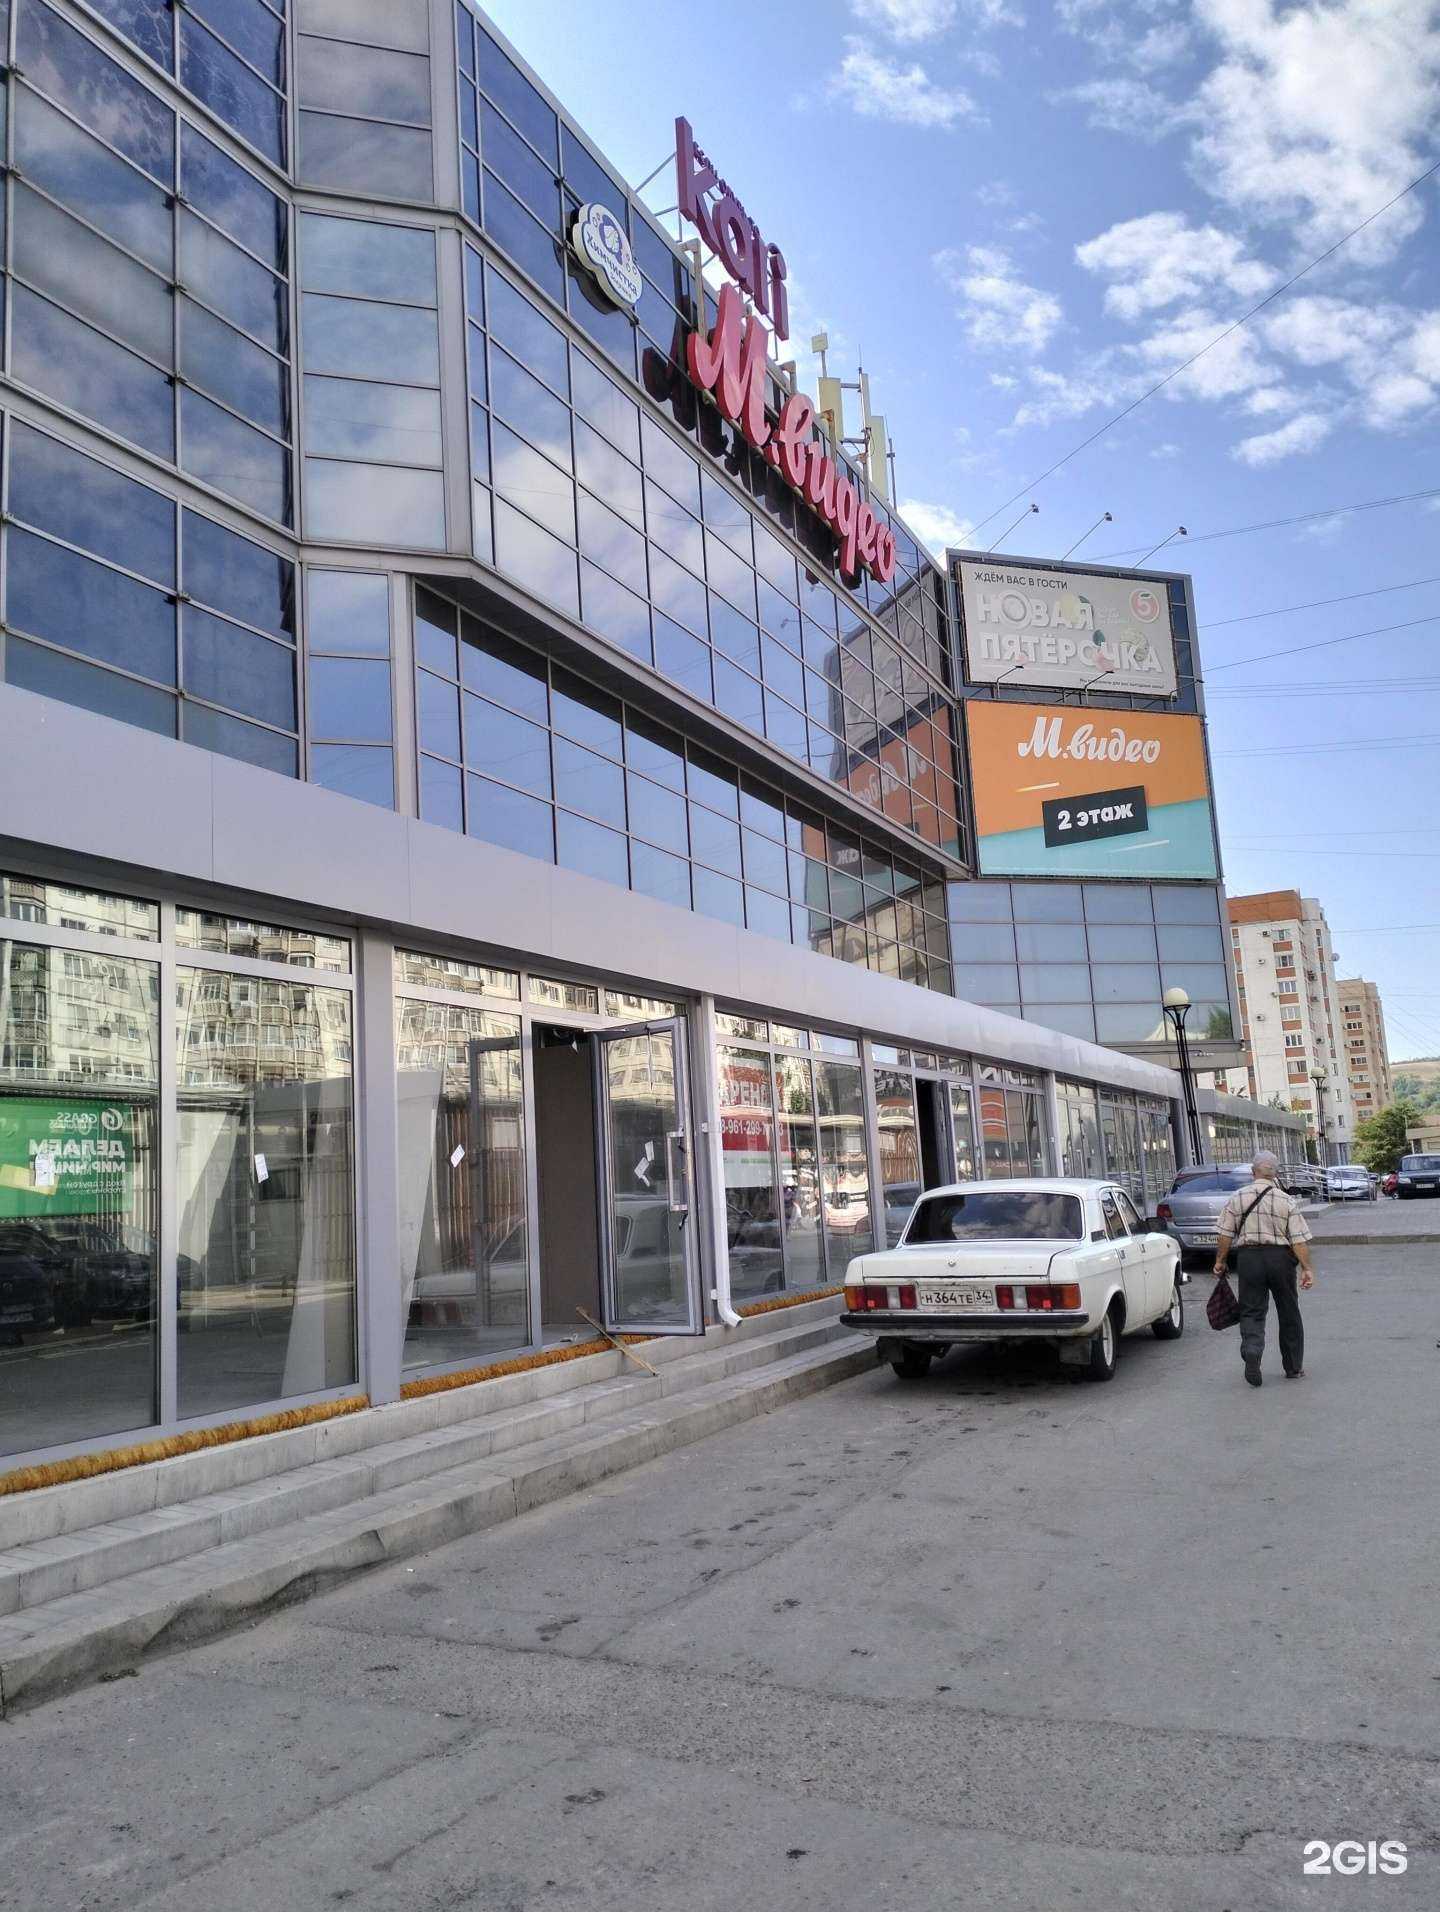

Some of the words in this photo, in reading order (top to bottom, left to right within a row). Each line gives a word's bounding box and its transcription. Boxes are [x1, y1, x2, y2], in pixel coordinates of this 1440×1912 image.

[675, 116, 790, 341] kari
[687, 281, 897, 583] М.видео
[974, 571, 1004, 584] ЖДЁМ
[1006, 575, 1026, 586] ВАС
[1028, 577, 1035, 586] В
[1037, 578, 1068, 590] ГОСТИ
[976, 589, 1095, 630] НОВАЯ
[1017, 716, 1161, 763] М.видео
[1057, 810, 1072, 830] 2
[1077, 803, 1134, 827] этаж
